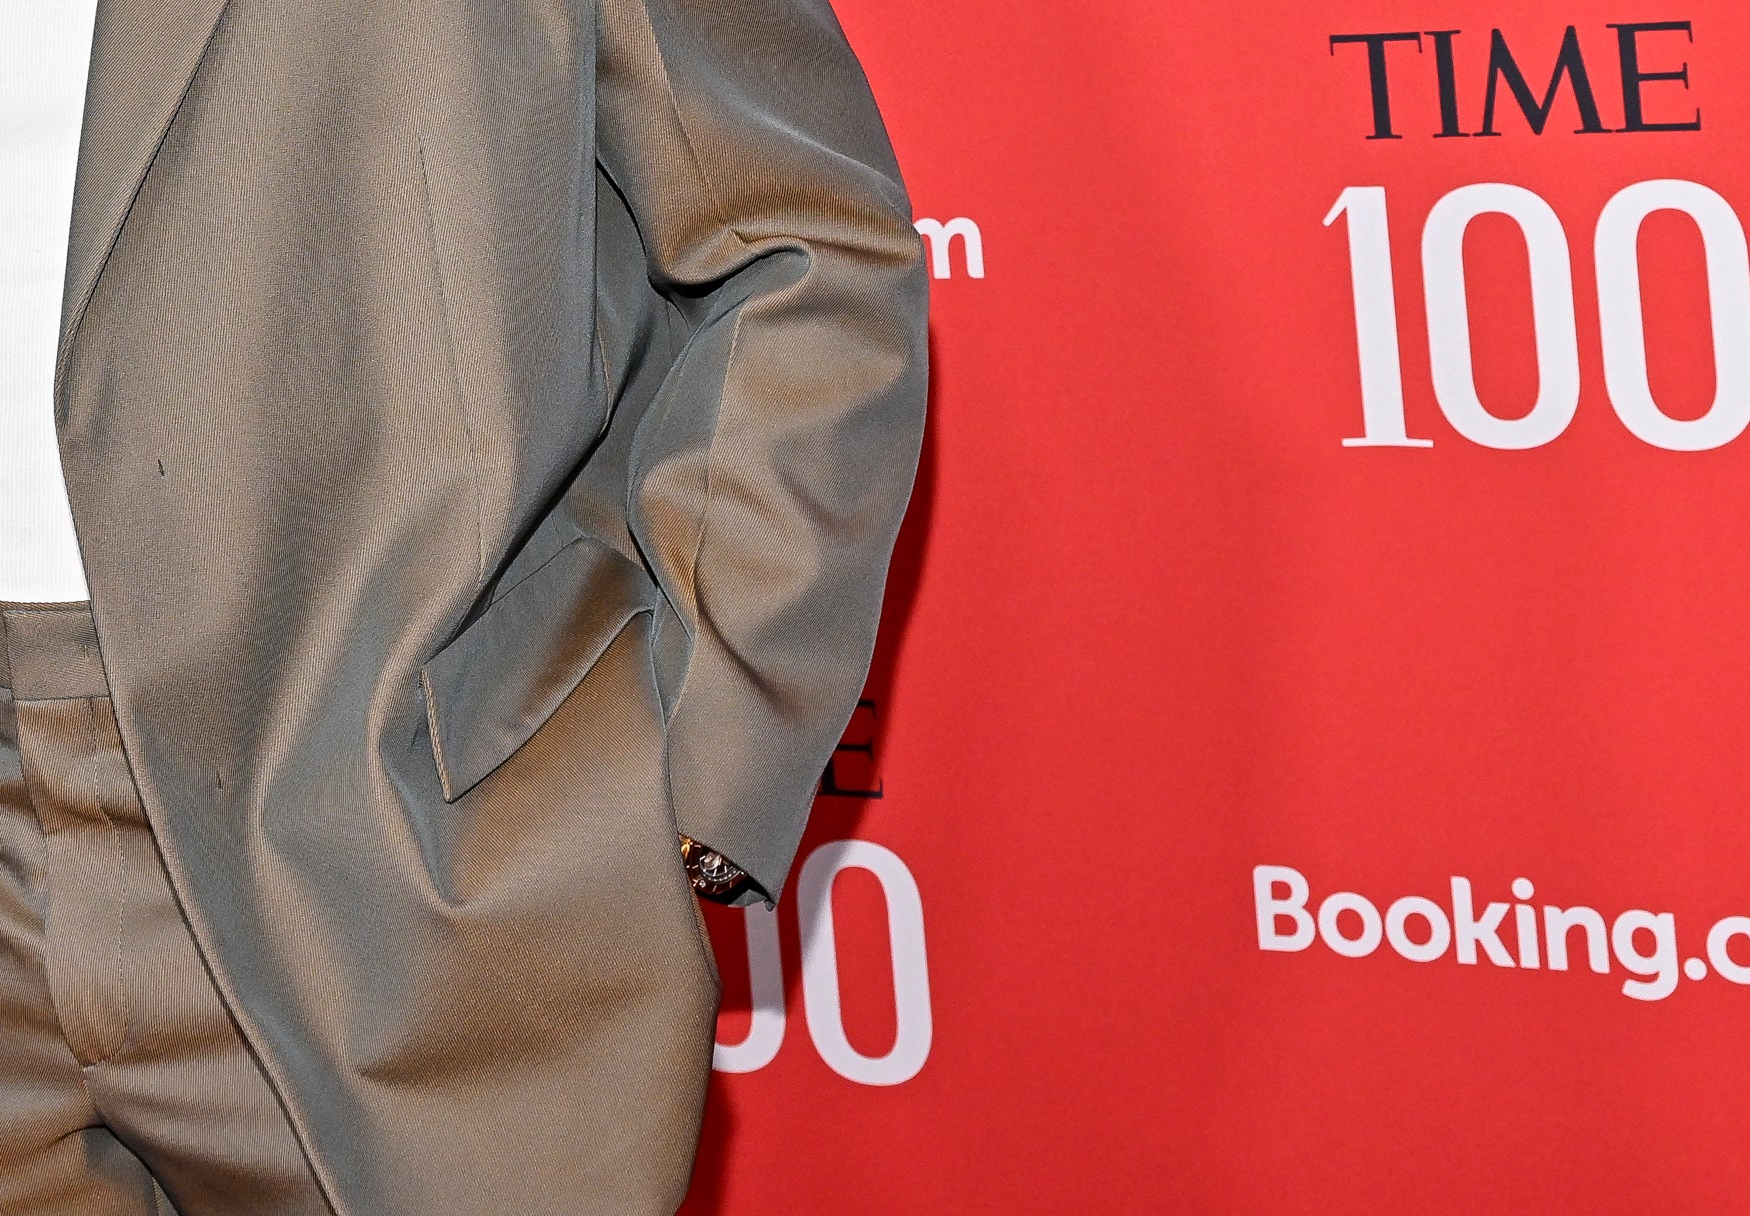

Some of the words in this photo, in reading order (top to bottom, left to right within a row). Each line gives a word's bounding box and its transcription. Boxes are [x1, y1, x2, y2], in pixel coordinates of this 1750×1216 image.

[1329, 20, 1702, 141] TIME
[1322, 178, 1750, 453] 100
[1252, 864, 1750, 1002] Booking.c
